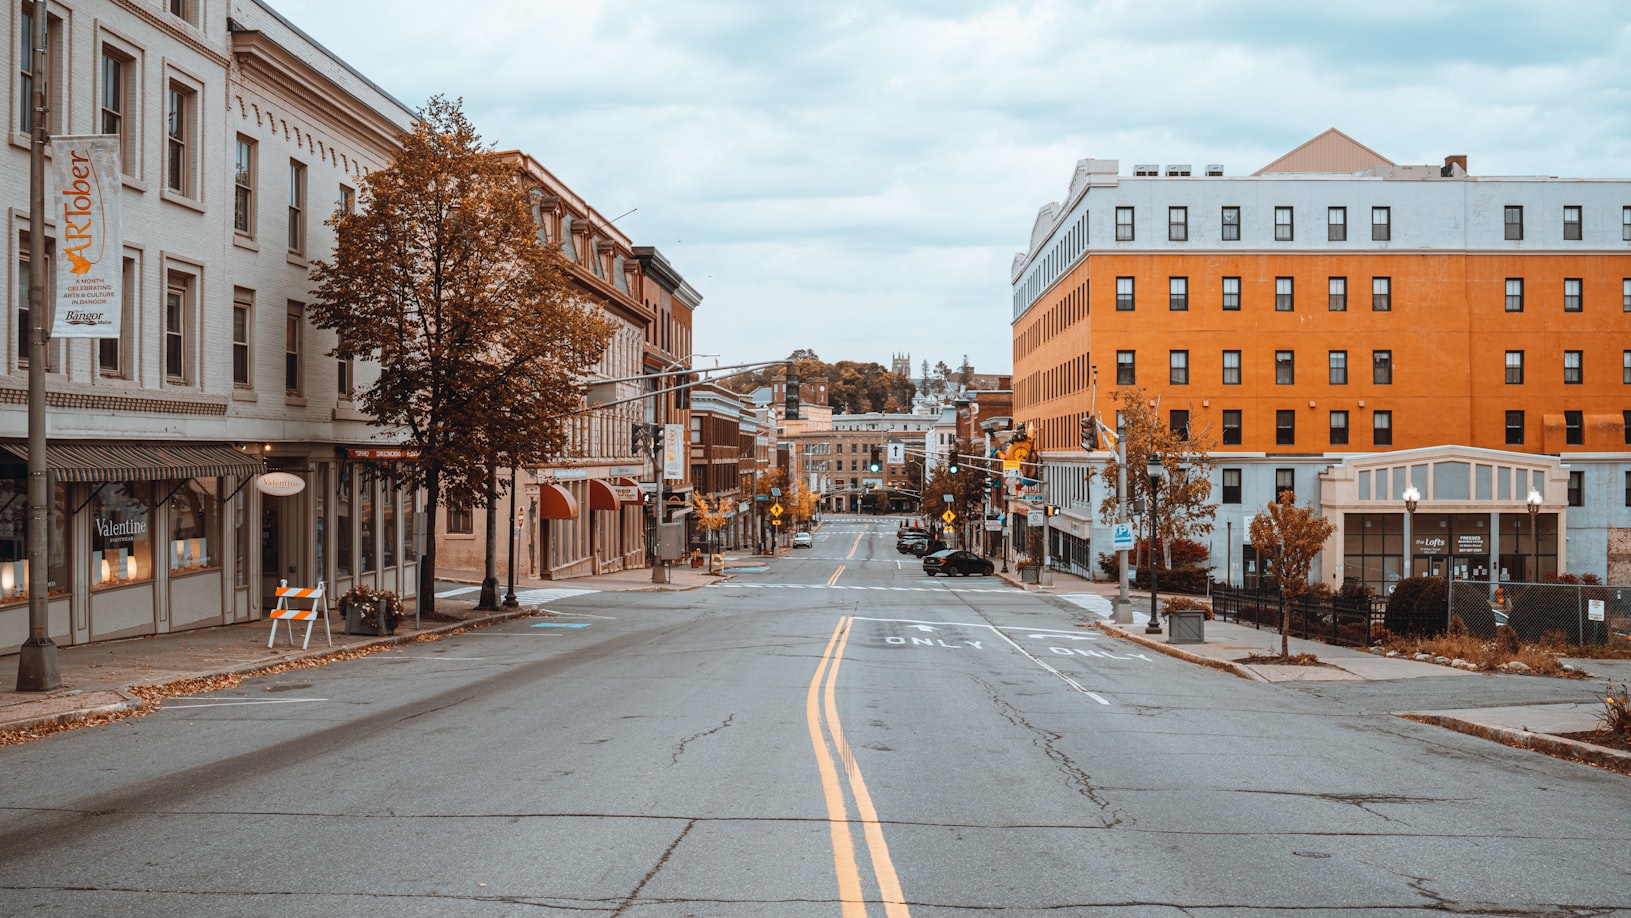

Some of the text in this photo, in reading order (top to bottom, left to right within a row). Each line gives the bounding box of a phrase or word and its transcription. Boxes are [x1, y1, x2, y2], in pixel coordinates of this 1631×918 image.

[65, 310, 104, 321] Bangor
[263, 479, 299, 487] Valentine
[95, 518, 147, 537] Valentine
[1425, 537, 1445, 547] Lofts
[885, 636, 982, 650] ONLY
[1048, 646, 1153, 662] ONLY
